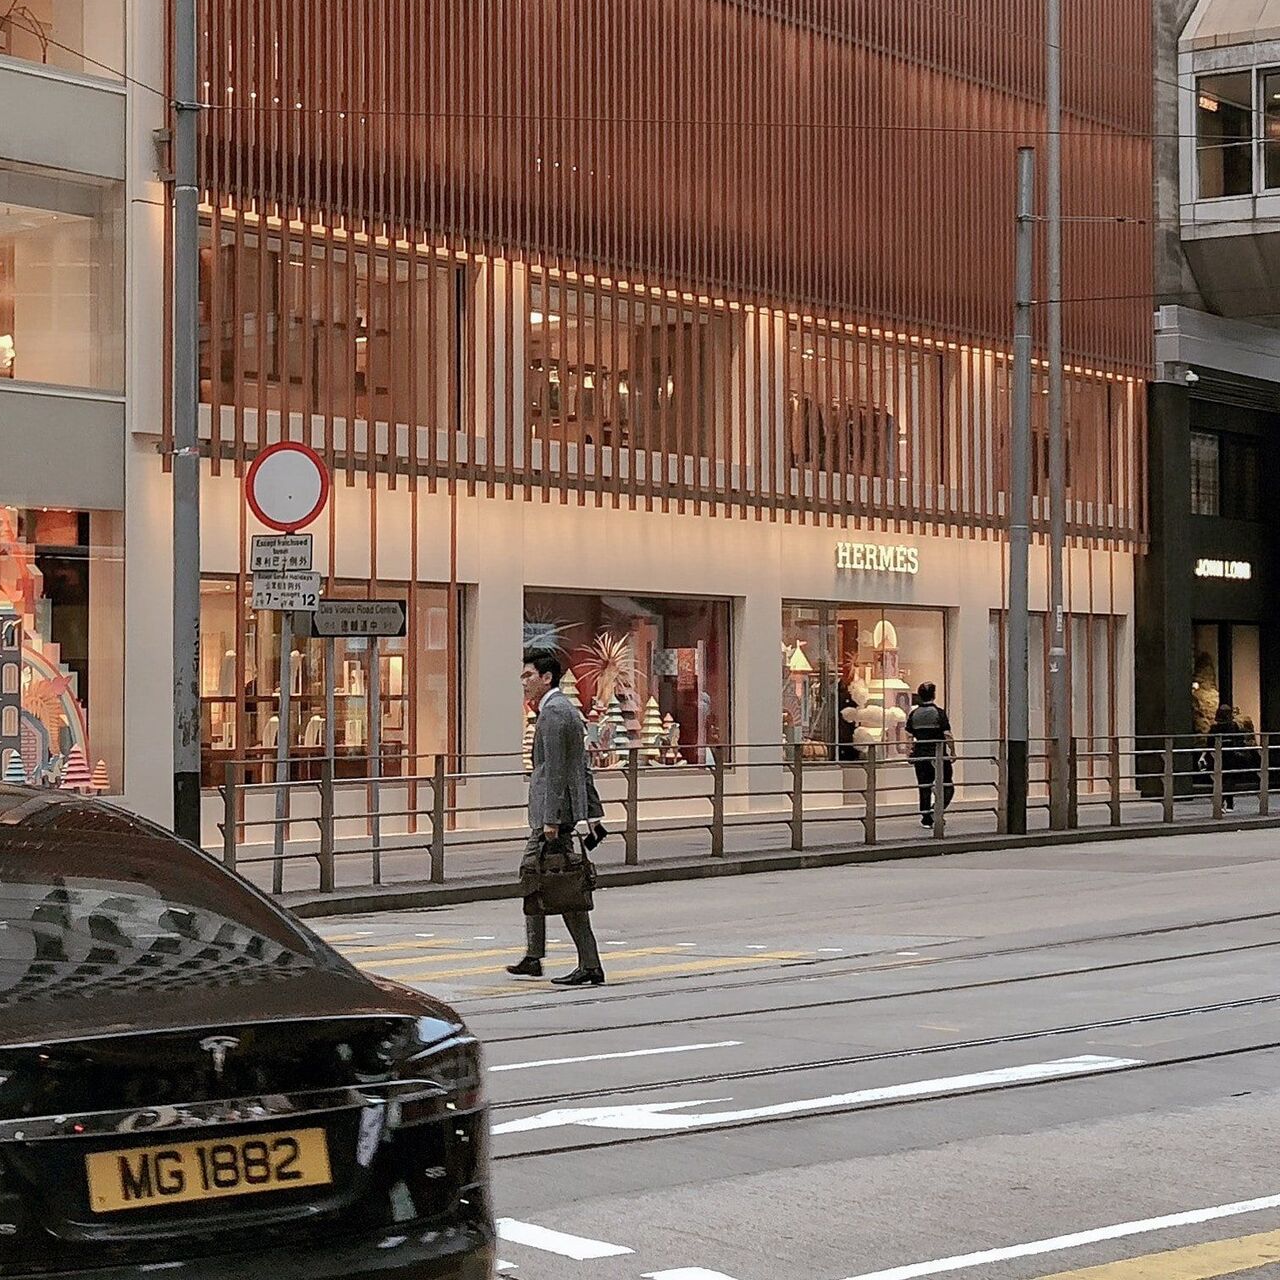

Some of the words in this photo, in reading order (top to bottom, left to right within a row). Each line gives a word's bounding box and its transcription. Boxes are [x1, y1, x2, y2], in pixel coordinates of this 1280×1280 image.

[836, 541, 919, 575] HERMÈS
[265, 592, 272, 605] 7
[302, 593, 316, 607] 12
[117, 1150, 186, 1201] MG
[195, 1136, 302, 1191] 1882
